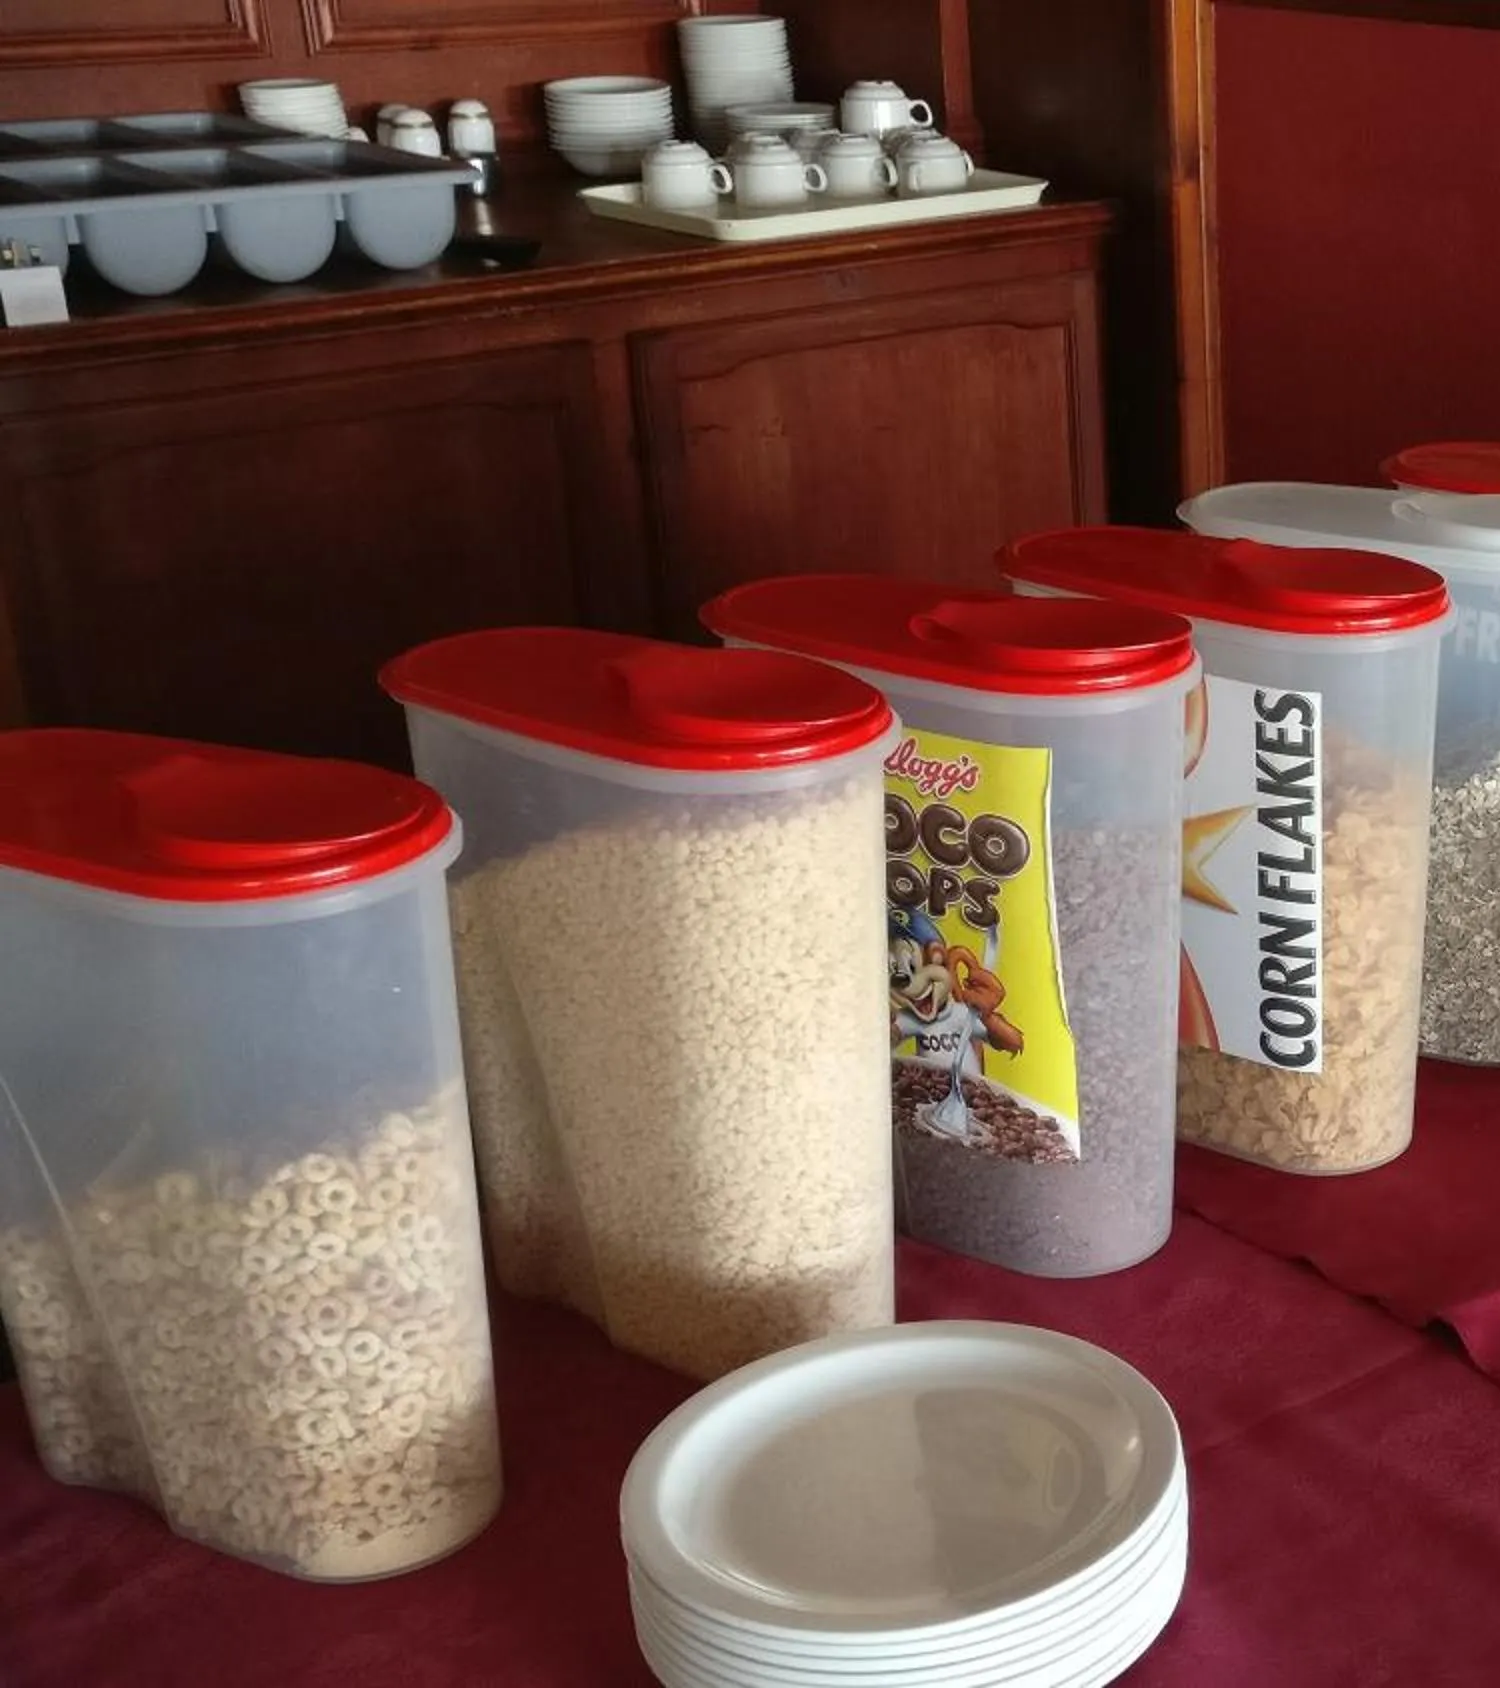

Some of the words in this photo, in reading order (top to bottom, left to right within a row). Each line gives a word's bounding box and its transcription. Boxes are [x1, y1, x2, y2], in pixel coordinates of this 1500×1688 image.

[884, 793, 1031, 878] OCO
[1254, 689, 1317, 905] FLAKES
[885, 859, 1001, 930] OPS
[1259, 911, 1317, 1069] CORN
